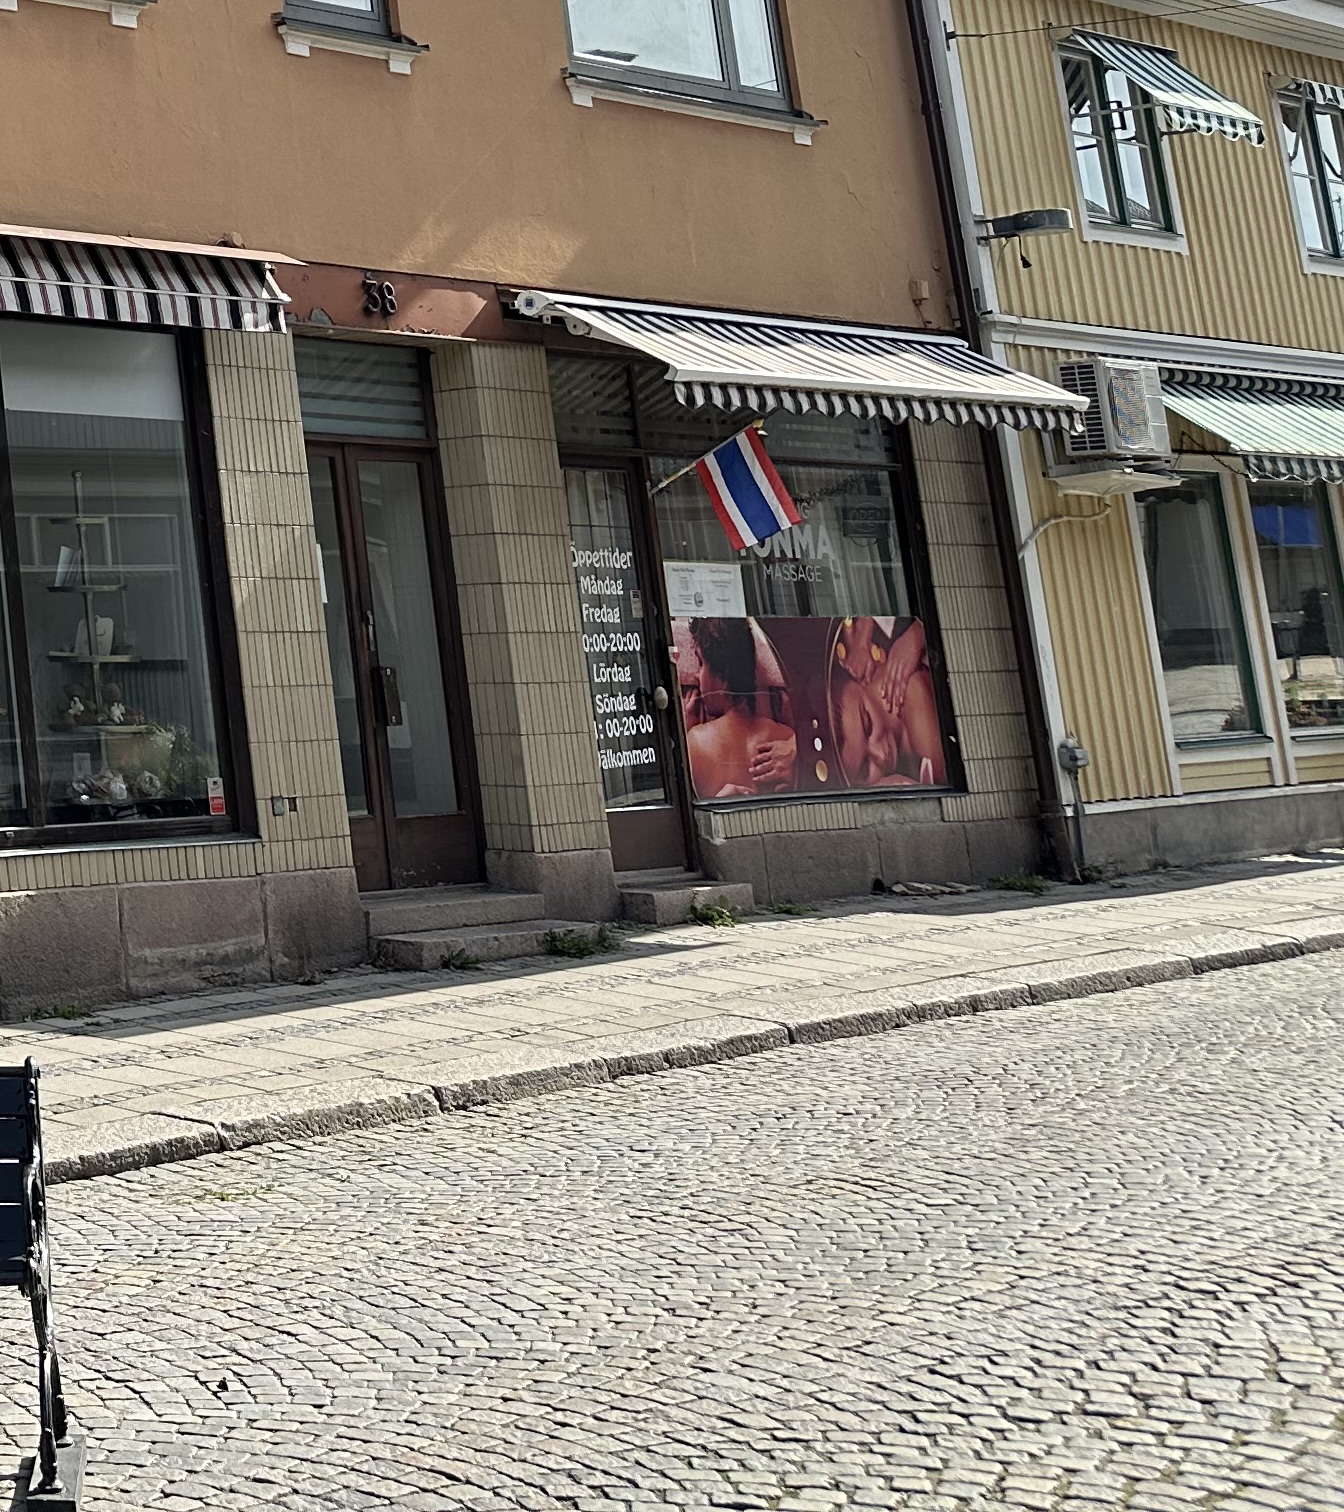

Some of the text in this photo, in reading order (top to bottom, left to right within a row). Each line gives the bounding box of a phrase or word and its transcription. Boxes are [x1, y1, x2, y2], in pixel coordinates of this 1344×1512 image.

[362, 280, 398, 313] 38
[763, 563, 823, 582] MASSAGE
[580, 574, 624, 595] Måndag
[582, 603, 621, 623] Fredag
[593, 662, 632, 683] Lördag
[595, 692, 637, 714] Söndag
